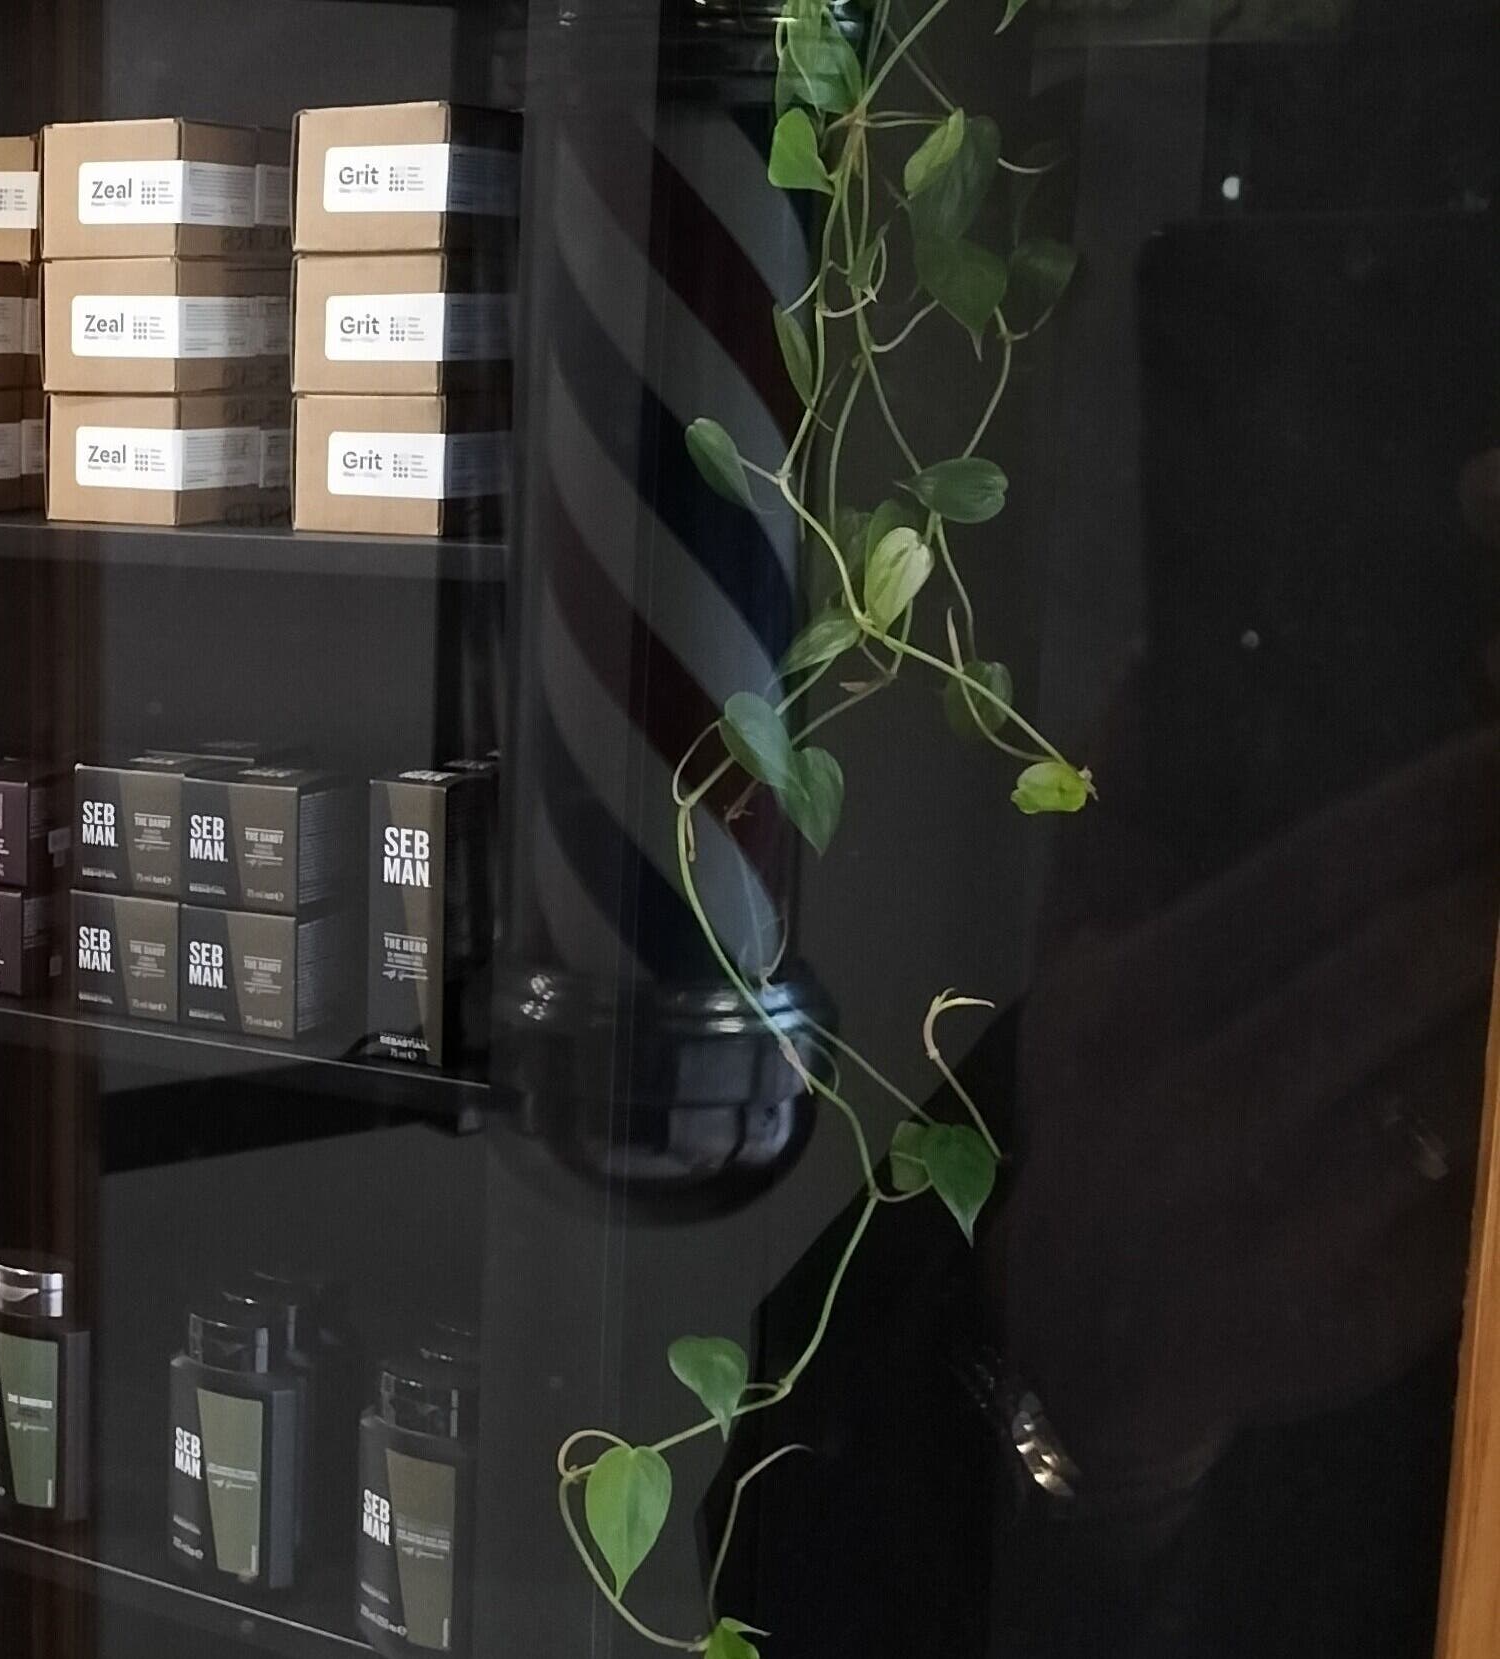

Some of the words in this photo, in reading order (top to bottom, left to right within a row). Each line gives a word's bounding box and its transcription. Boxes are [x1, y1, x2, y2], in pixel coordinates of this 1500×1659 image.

[339, 163, 380, 186] Grit
[92, 178, 133, 200] Zeal
[84, 313, 124, 334] Zeal
[340, 313, 380, 335] Grit
[88, 445, 127, 466] Zeal
[343, 450, 382, 472] Grit
[82, 800, 116, 826] SEB
[190, 814, 225, 840] SEB
[384, 826, 430, 861] SEB
[79, 925, 111, 952] SEB
[189, 941, 223, 968] SEB
[175, 1426, 201, 1458] SEB
[363, 1488, 390, 1523] SEB
